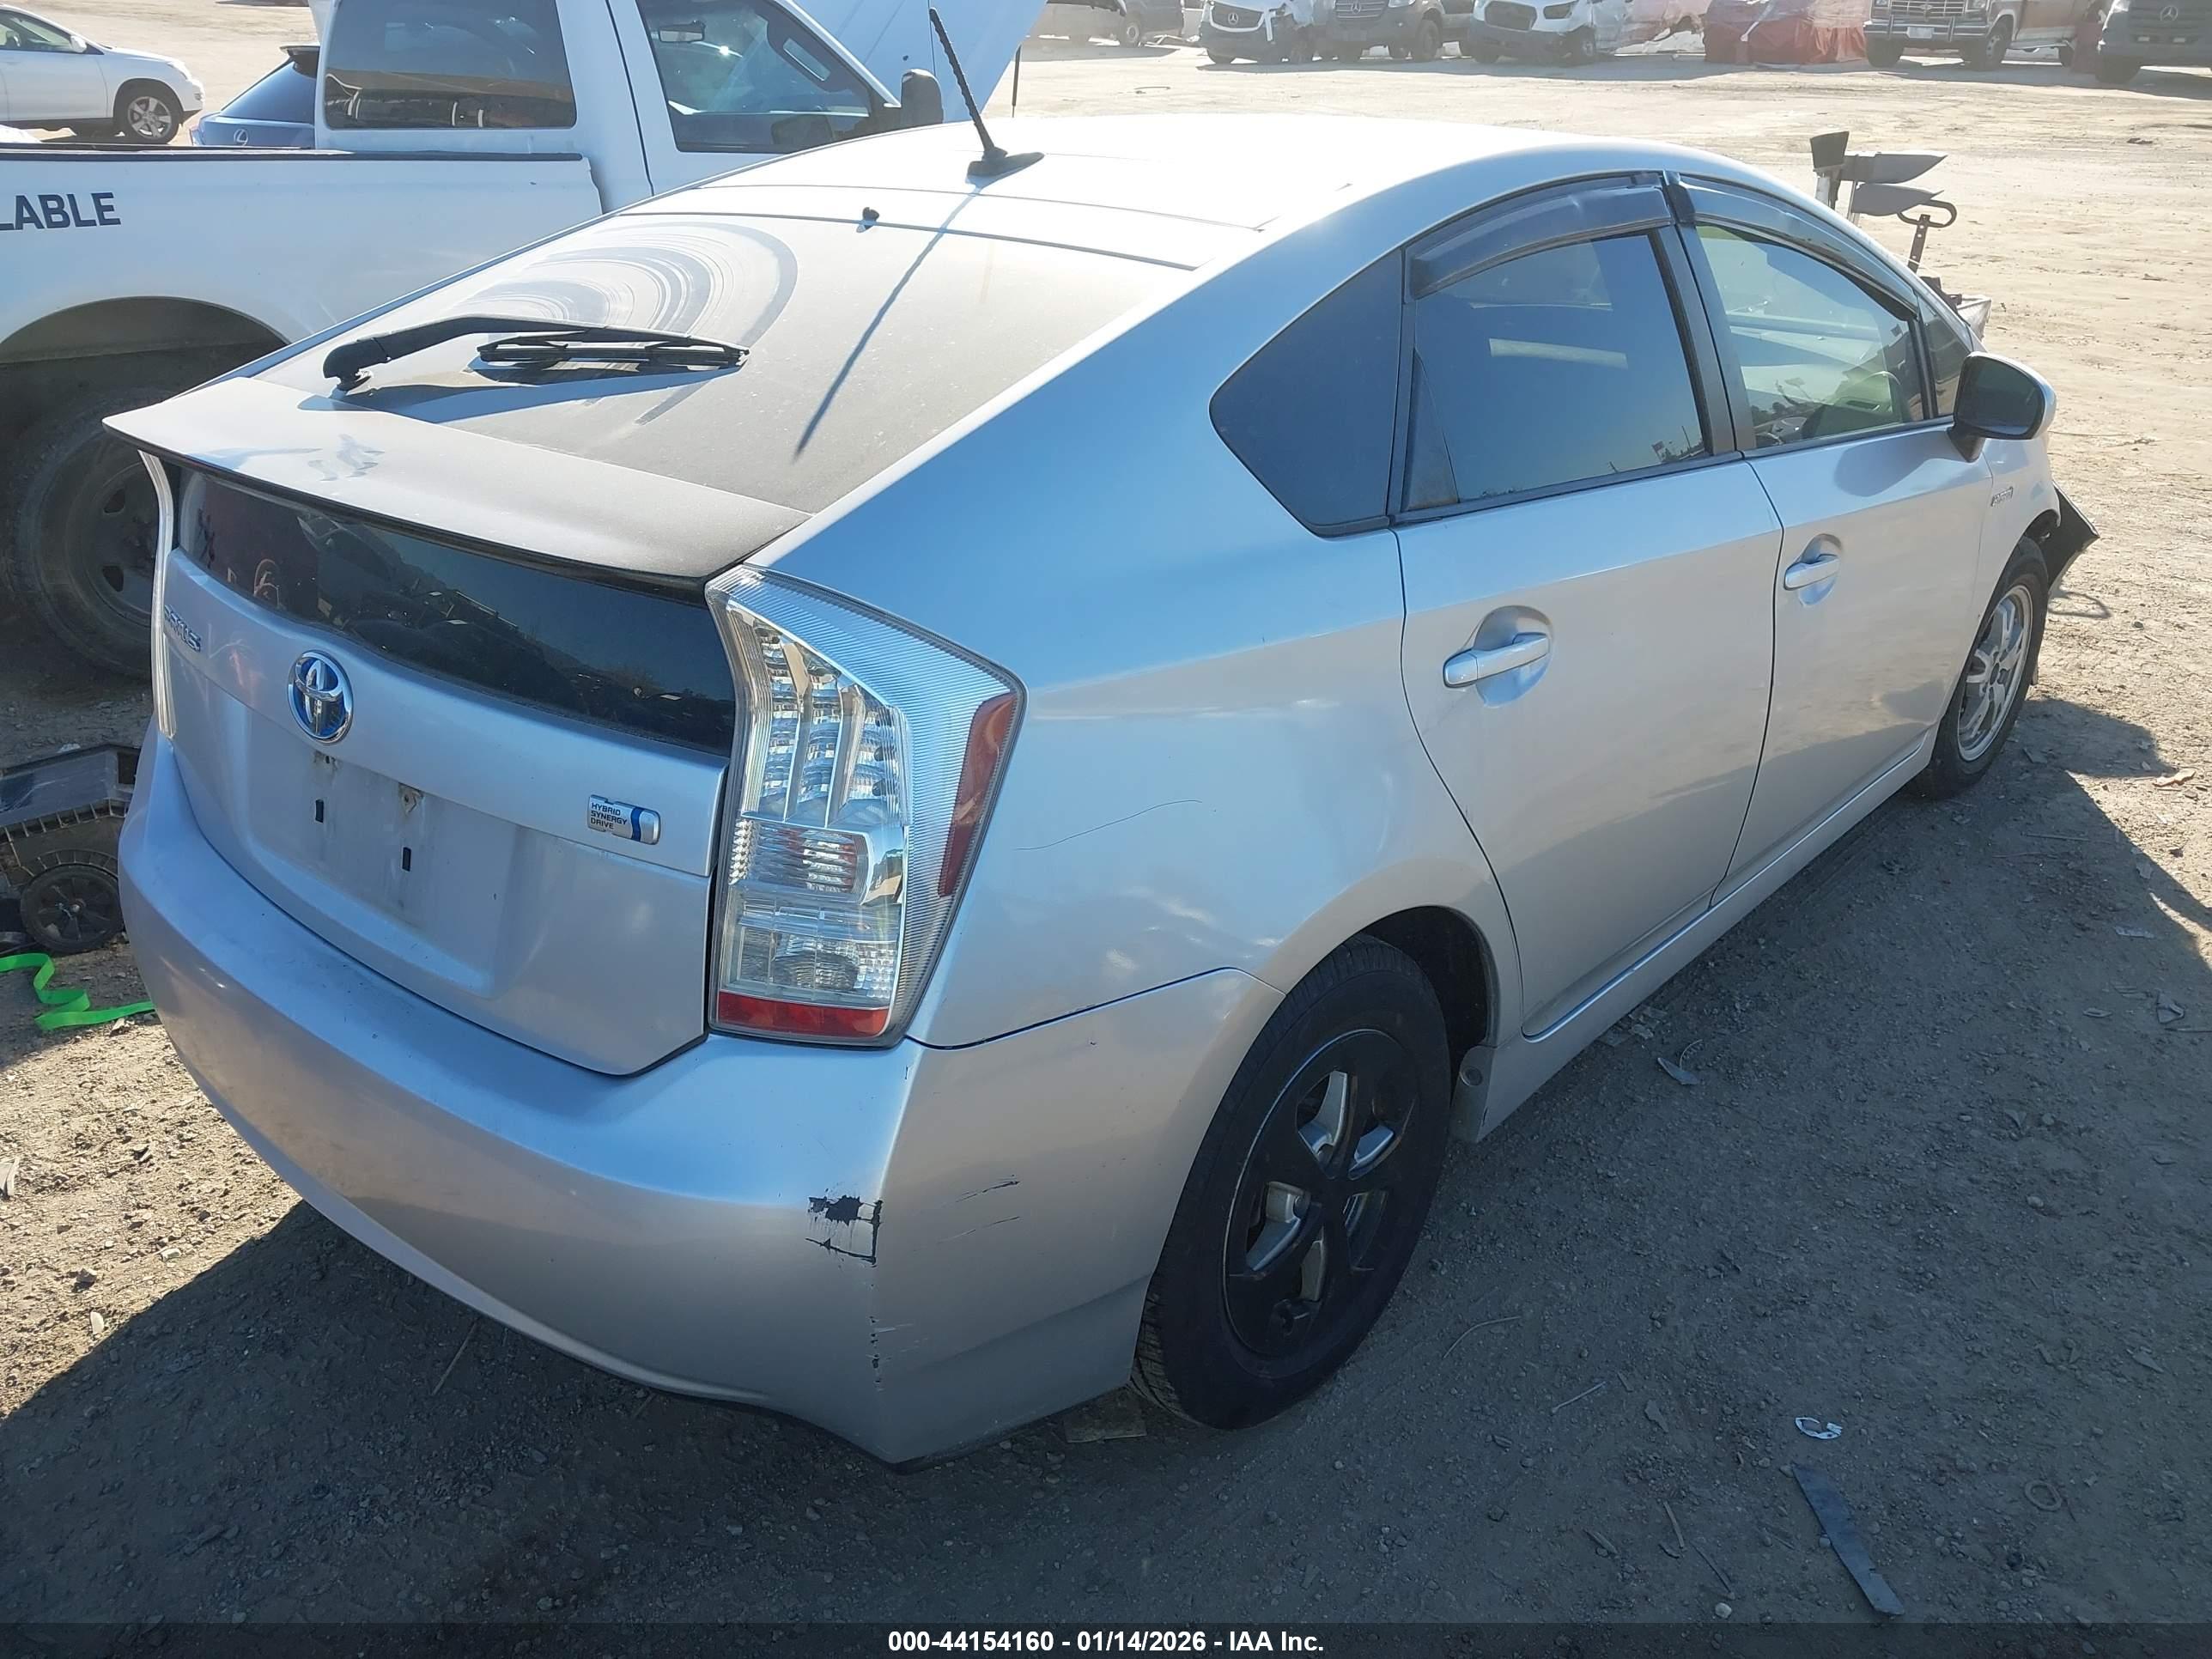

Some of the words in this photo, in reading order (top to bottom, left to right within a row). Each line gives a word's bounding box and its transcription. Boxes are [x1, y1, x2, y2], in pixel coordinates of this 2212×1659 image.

[591, 802, 621, 816] HYBRID
[590, 810, 628, 825] SYNERGY
[590, 817, 615, 830] DRIVE
